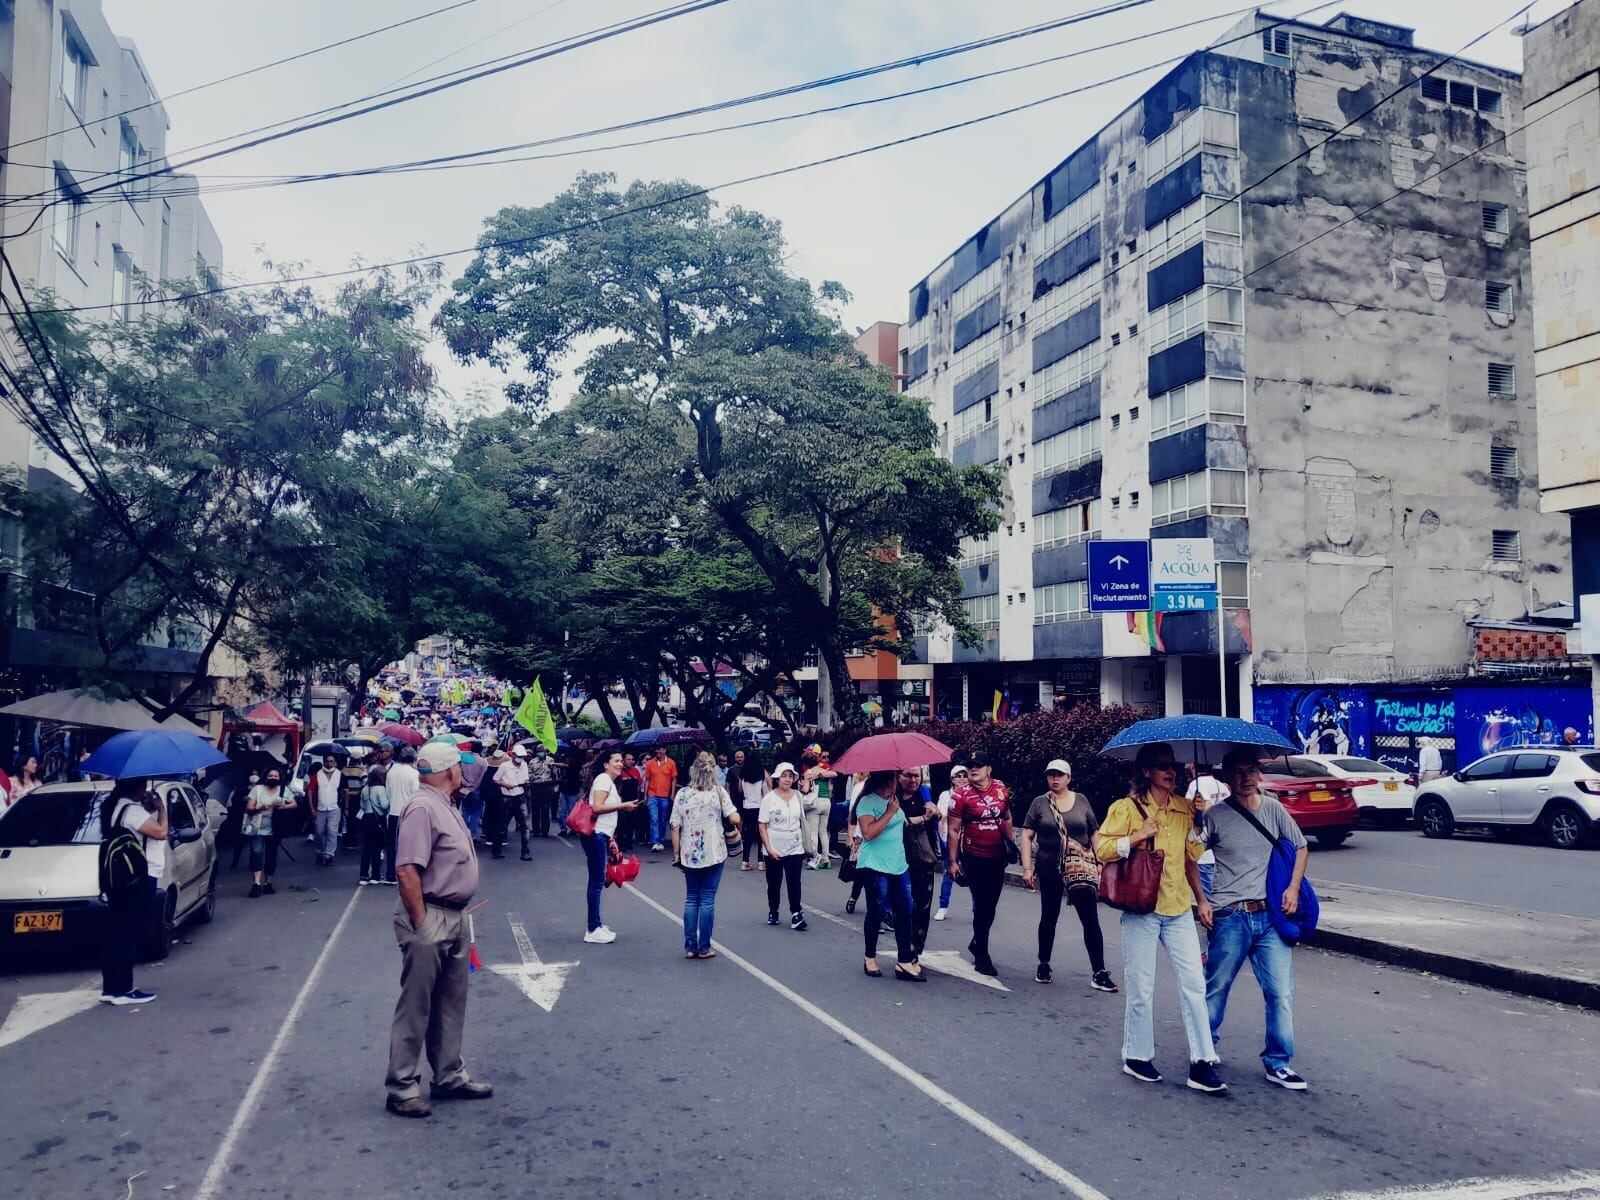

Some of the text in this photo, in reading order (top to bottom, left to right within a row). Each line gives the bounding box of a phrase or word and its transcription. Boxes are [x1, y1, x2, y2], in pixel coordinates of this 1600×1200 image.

[1160, 562, 1210, 576] ACQUA
[1110, 582, 1129, 590] Zona
[1130, 582, 1140, 590] de
[1092, 594, 1147, 602] Reclutamiento
[1167, 594, 1205, 609] 3.9 Km
[1374, 699, 1422, 718] Festival
